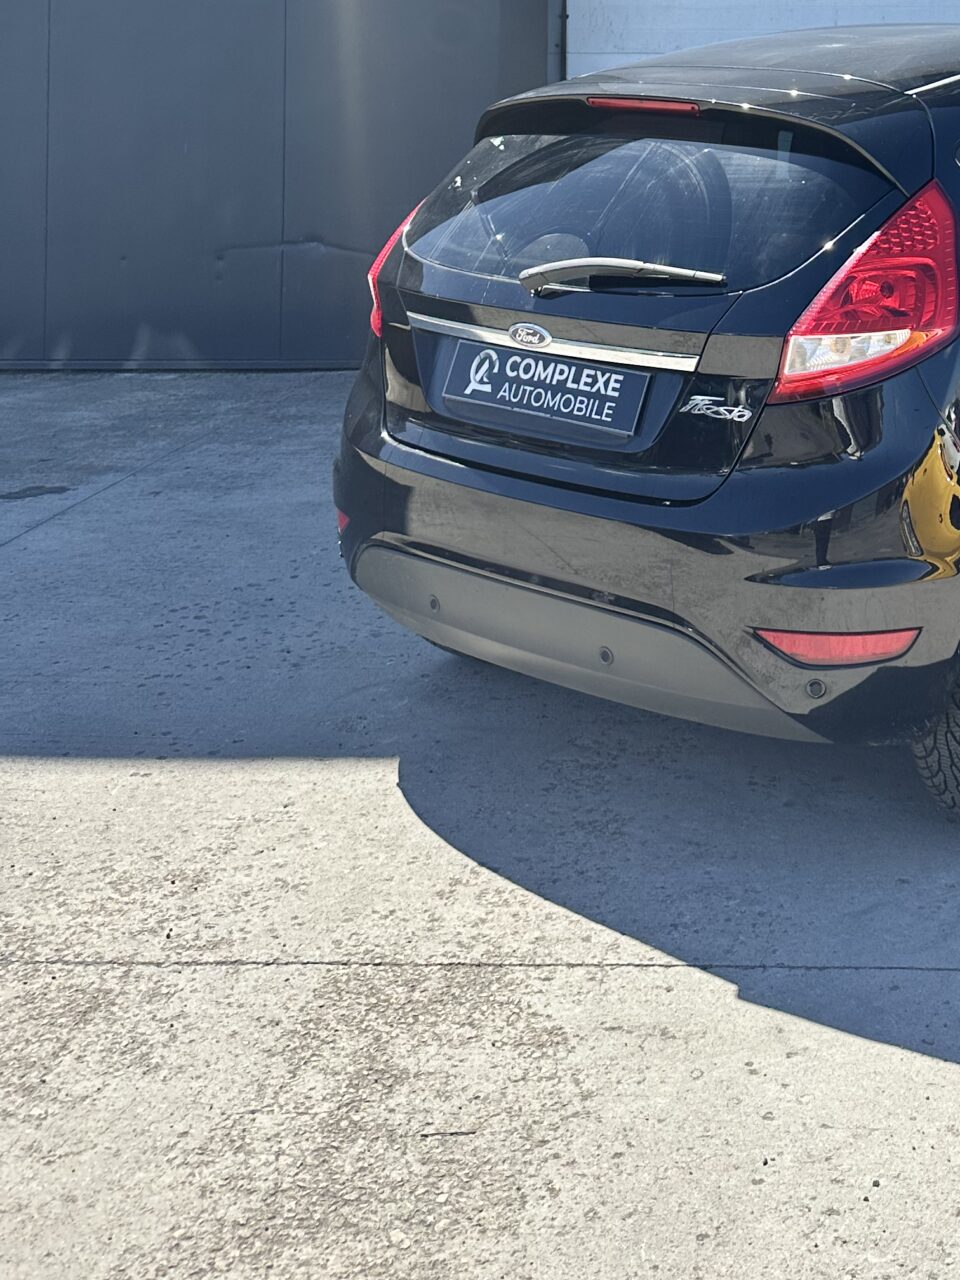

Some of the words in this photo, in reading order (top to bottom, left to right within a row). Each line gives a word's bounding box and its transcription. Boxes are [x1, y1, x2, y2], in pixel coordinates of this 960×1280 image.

[515, 328, 541, 345] Ford
[505, 355, 624, 398] COMPLEXE
[497, 381, 617, 422] AUTOMOBILE
